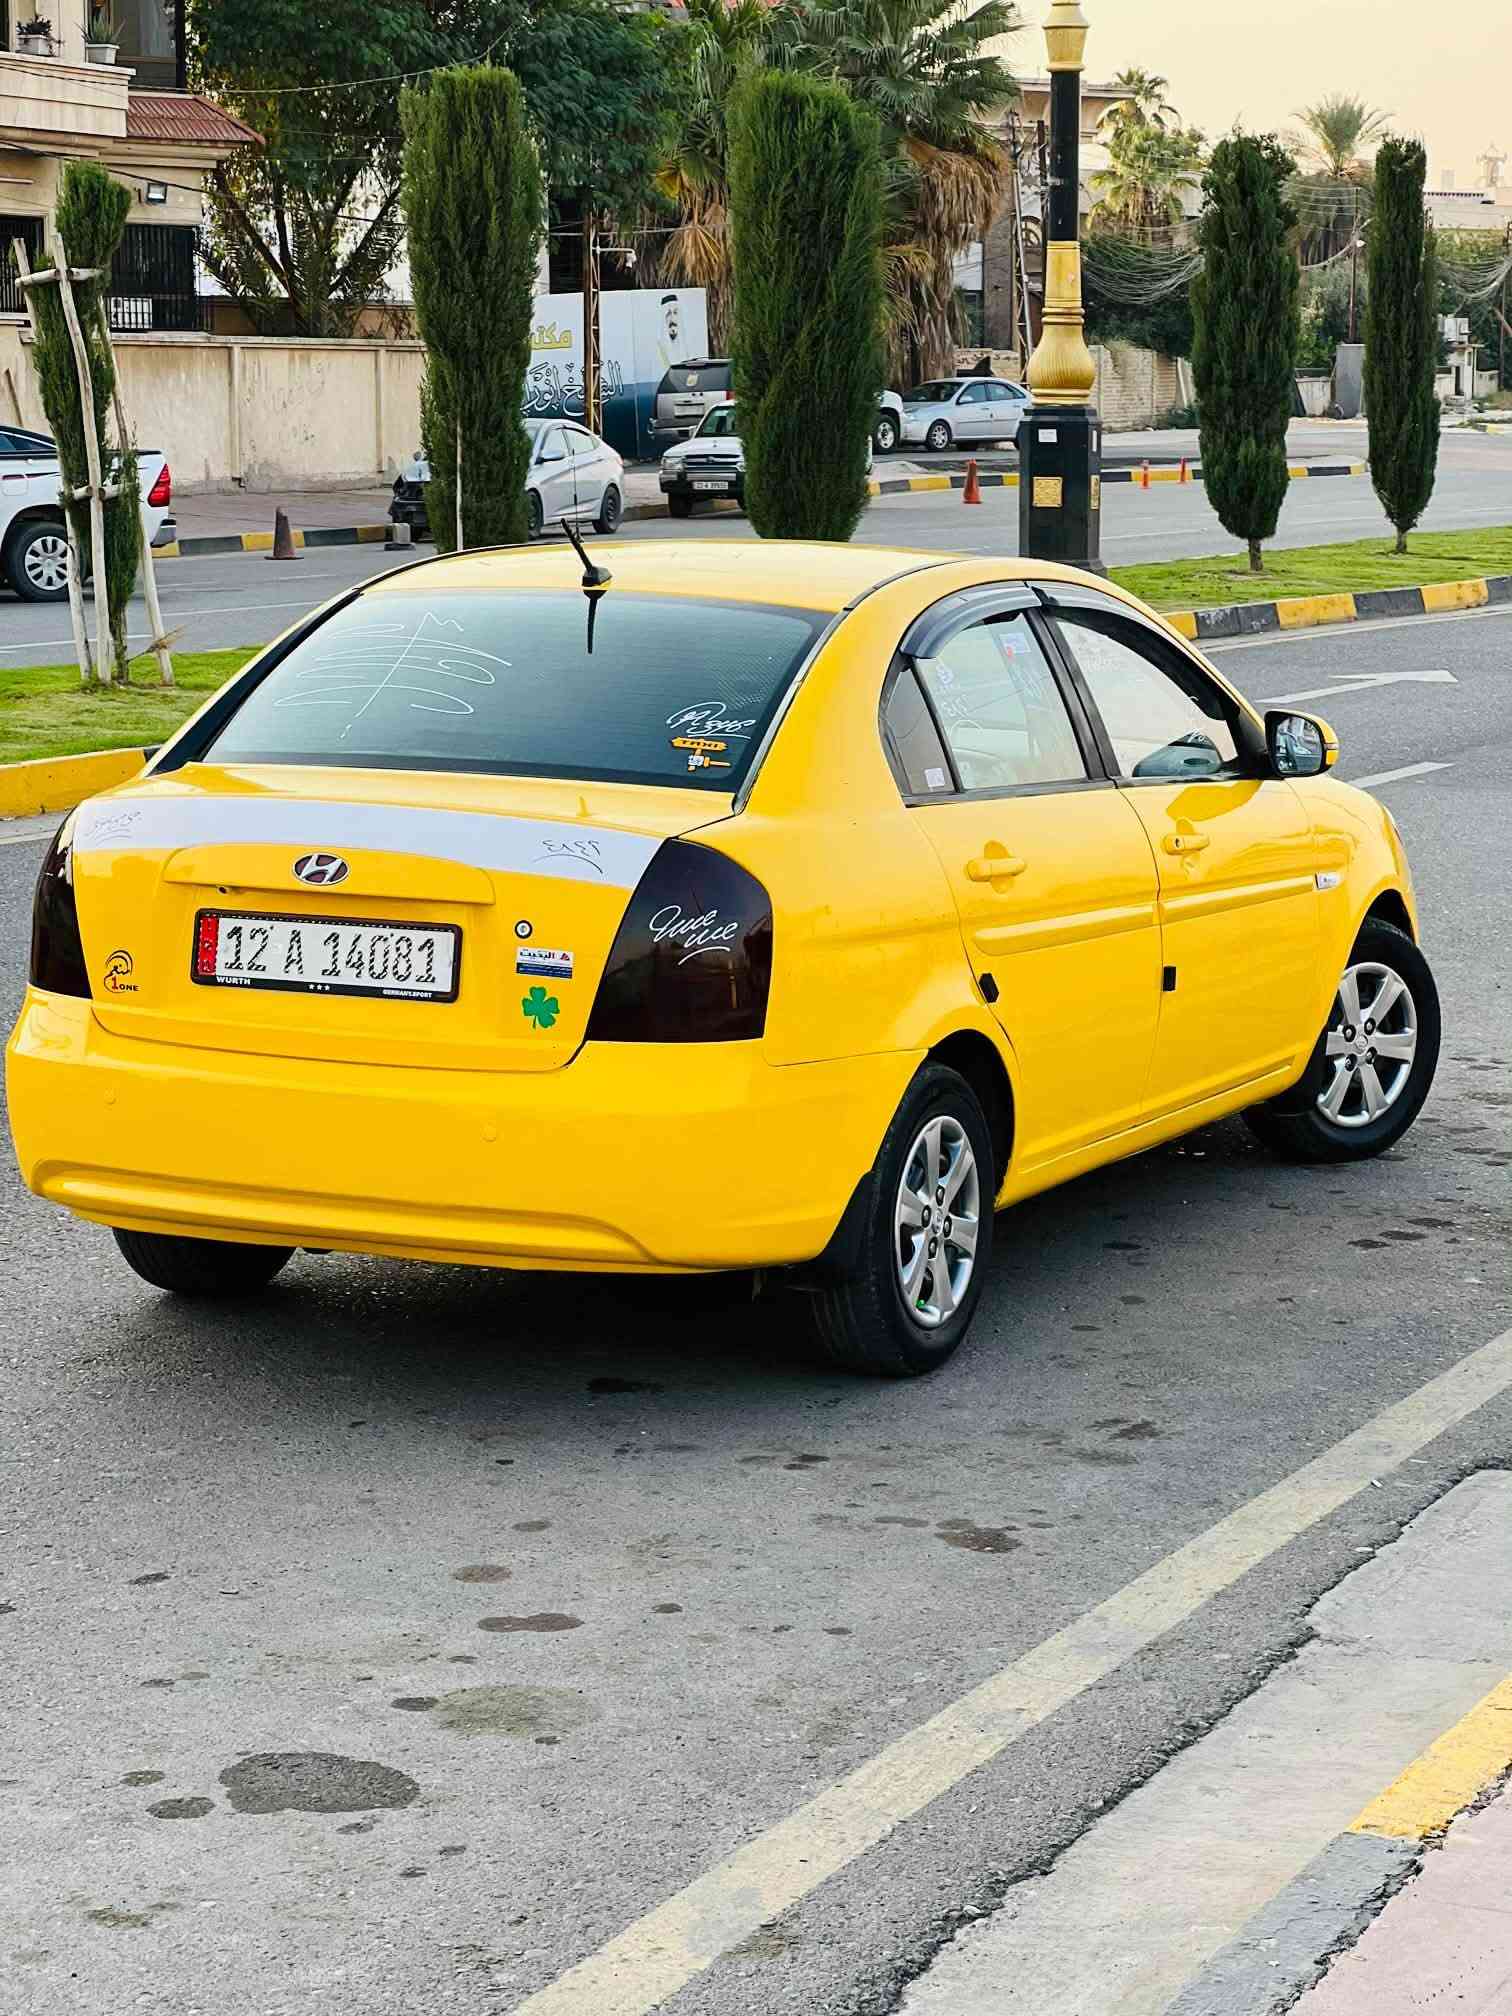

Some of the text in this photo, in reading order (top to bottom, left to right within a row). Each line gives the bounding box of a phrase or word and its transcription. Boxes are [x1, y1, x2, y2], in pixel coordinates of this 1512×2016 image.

[528, 321, 572, 351] مكت
[225, 926, 269, 972] 12
[284, 929, 304, 974] A
[321, 932, 436, 984] 14081
[216, 976, 251, 985] WURTH
